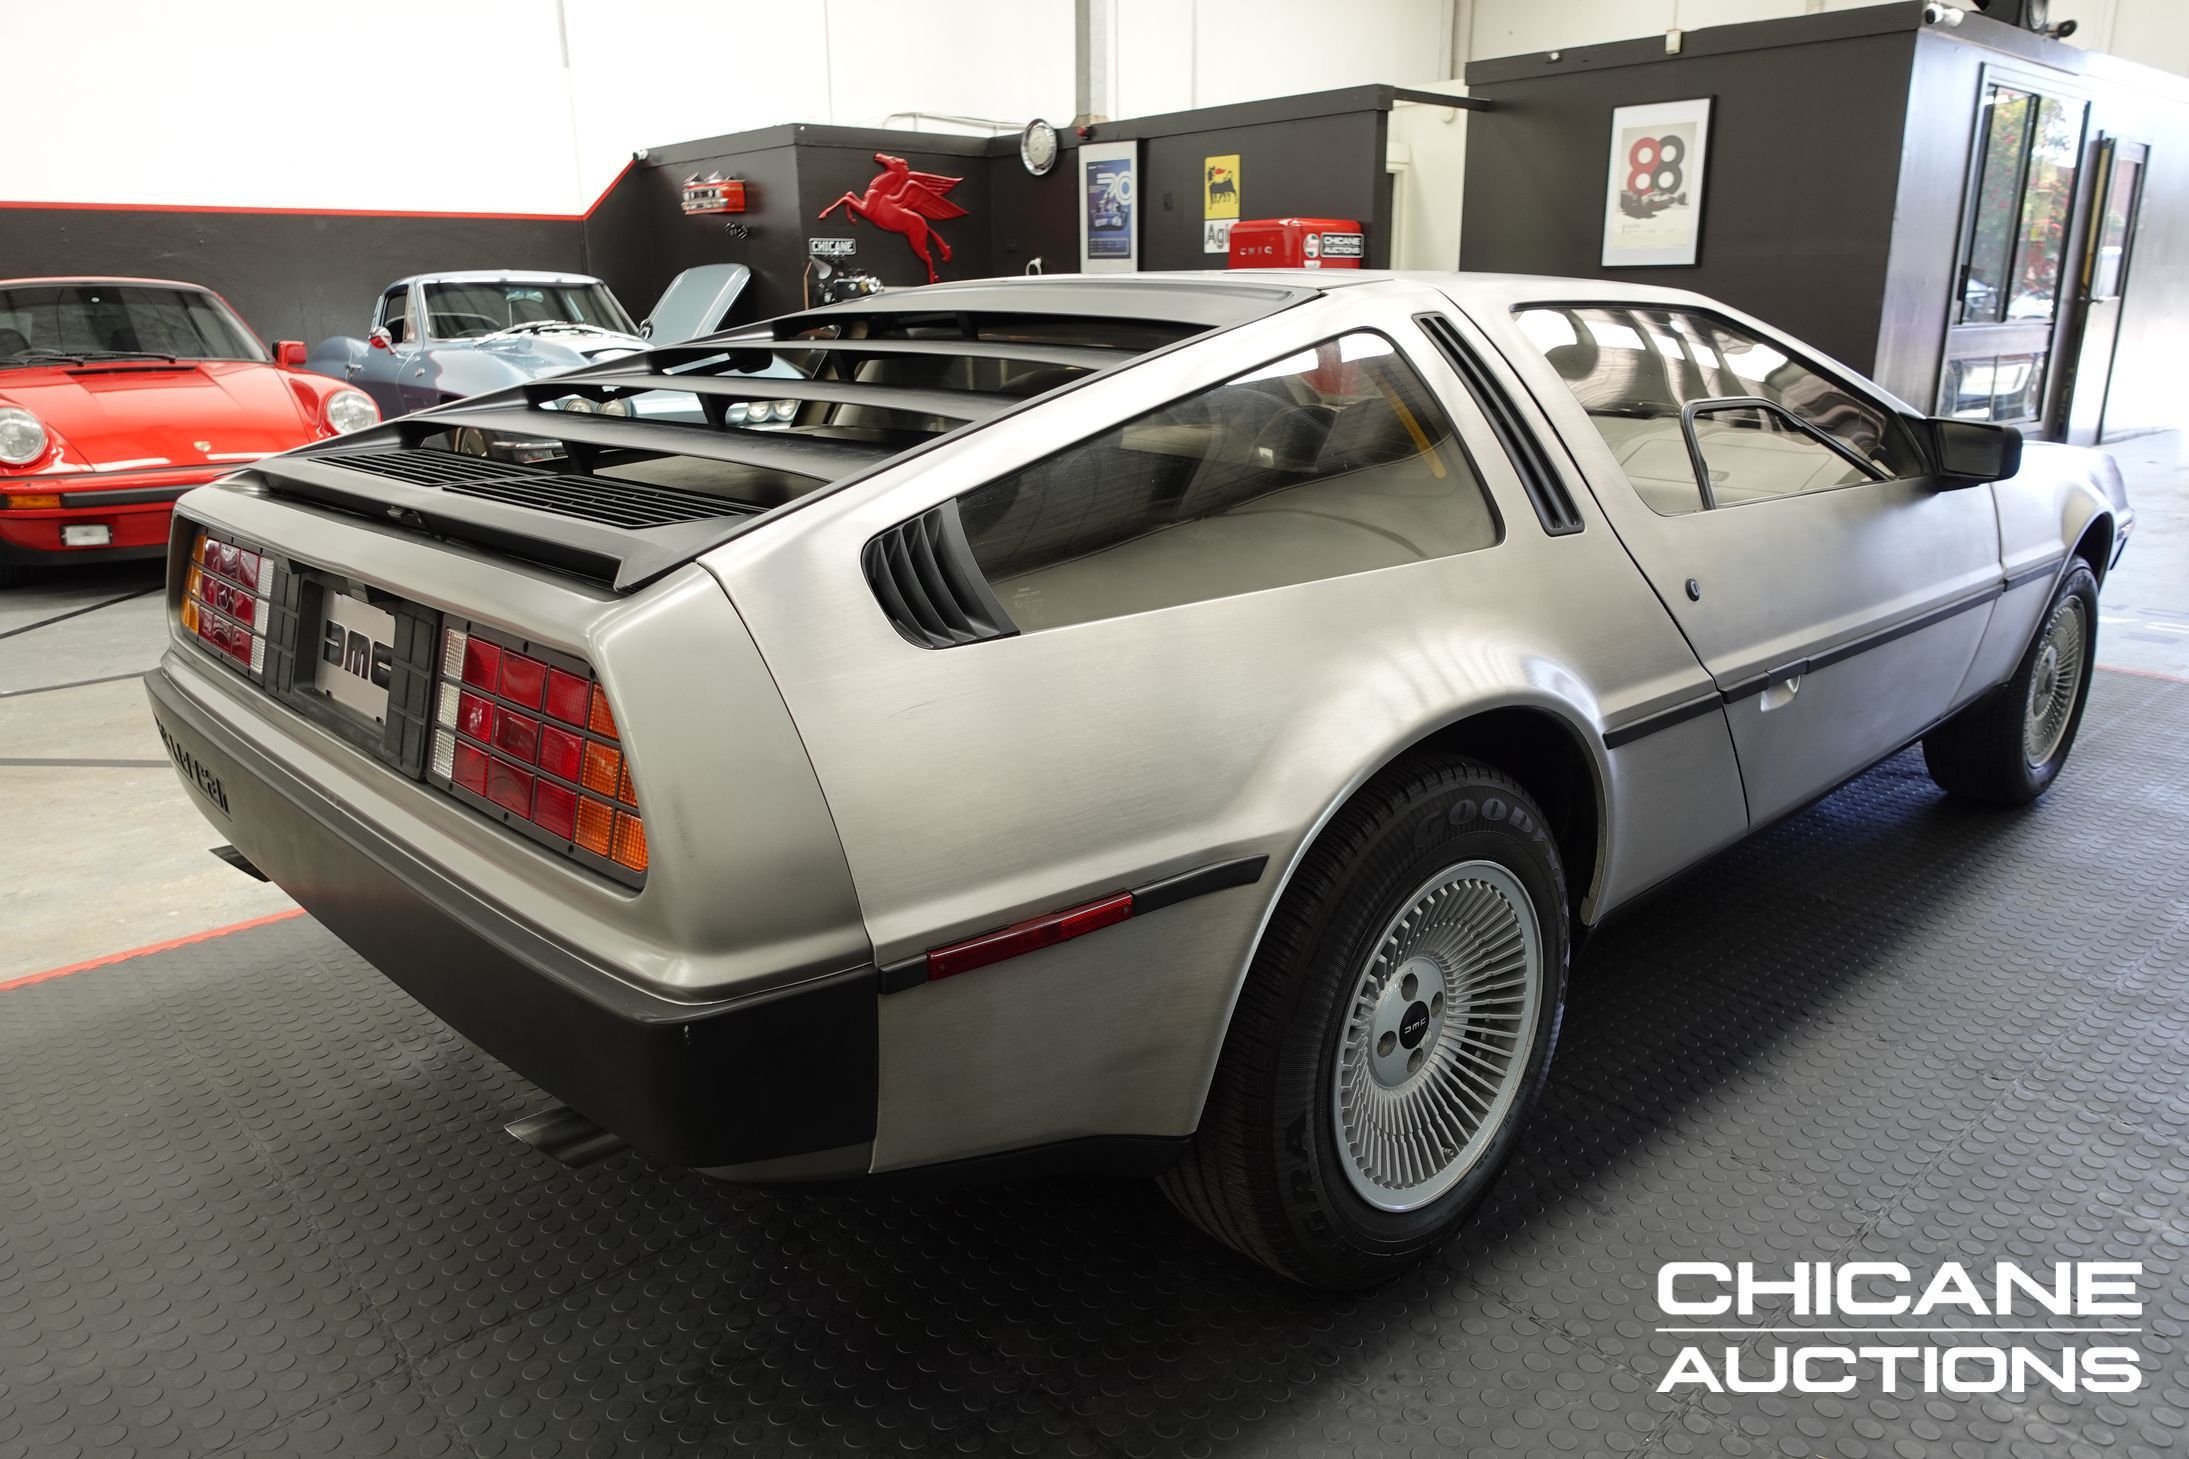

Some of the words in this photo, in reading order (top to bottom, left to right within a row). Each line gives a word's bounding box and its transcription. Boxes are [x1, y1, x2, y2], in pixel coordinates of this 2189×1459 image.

[1627, 135, 1685, 196] 88
[1206, 223, 1230, 249] Agi
[1324, 236, 1361, 245] CHICANE
[812, 241, 853, 252] CHICANE
[1324, 246, 1361, 254] AUCTIONS
